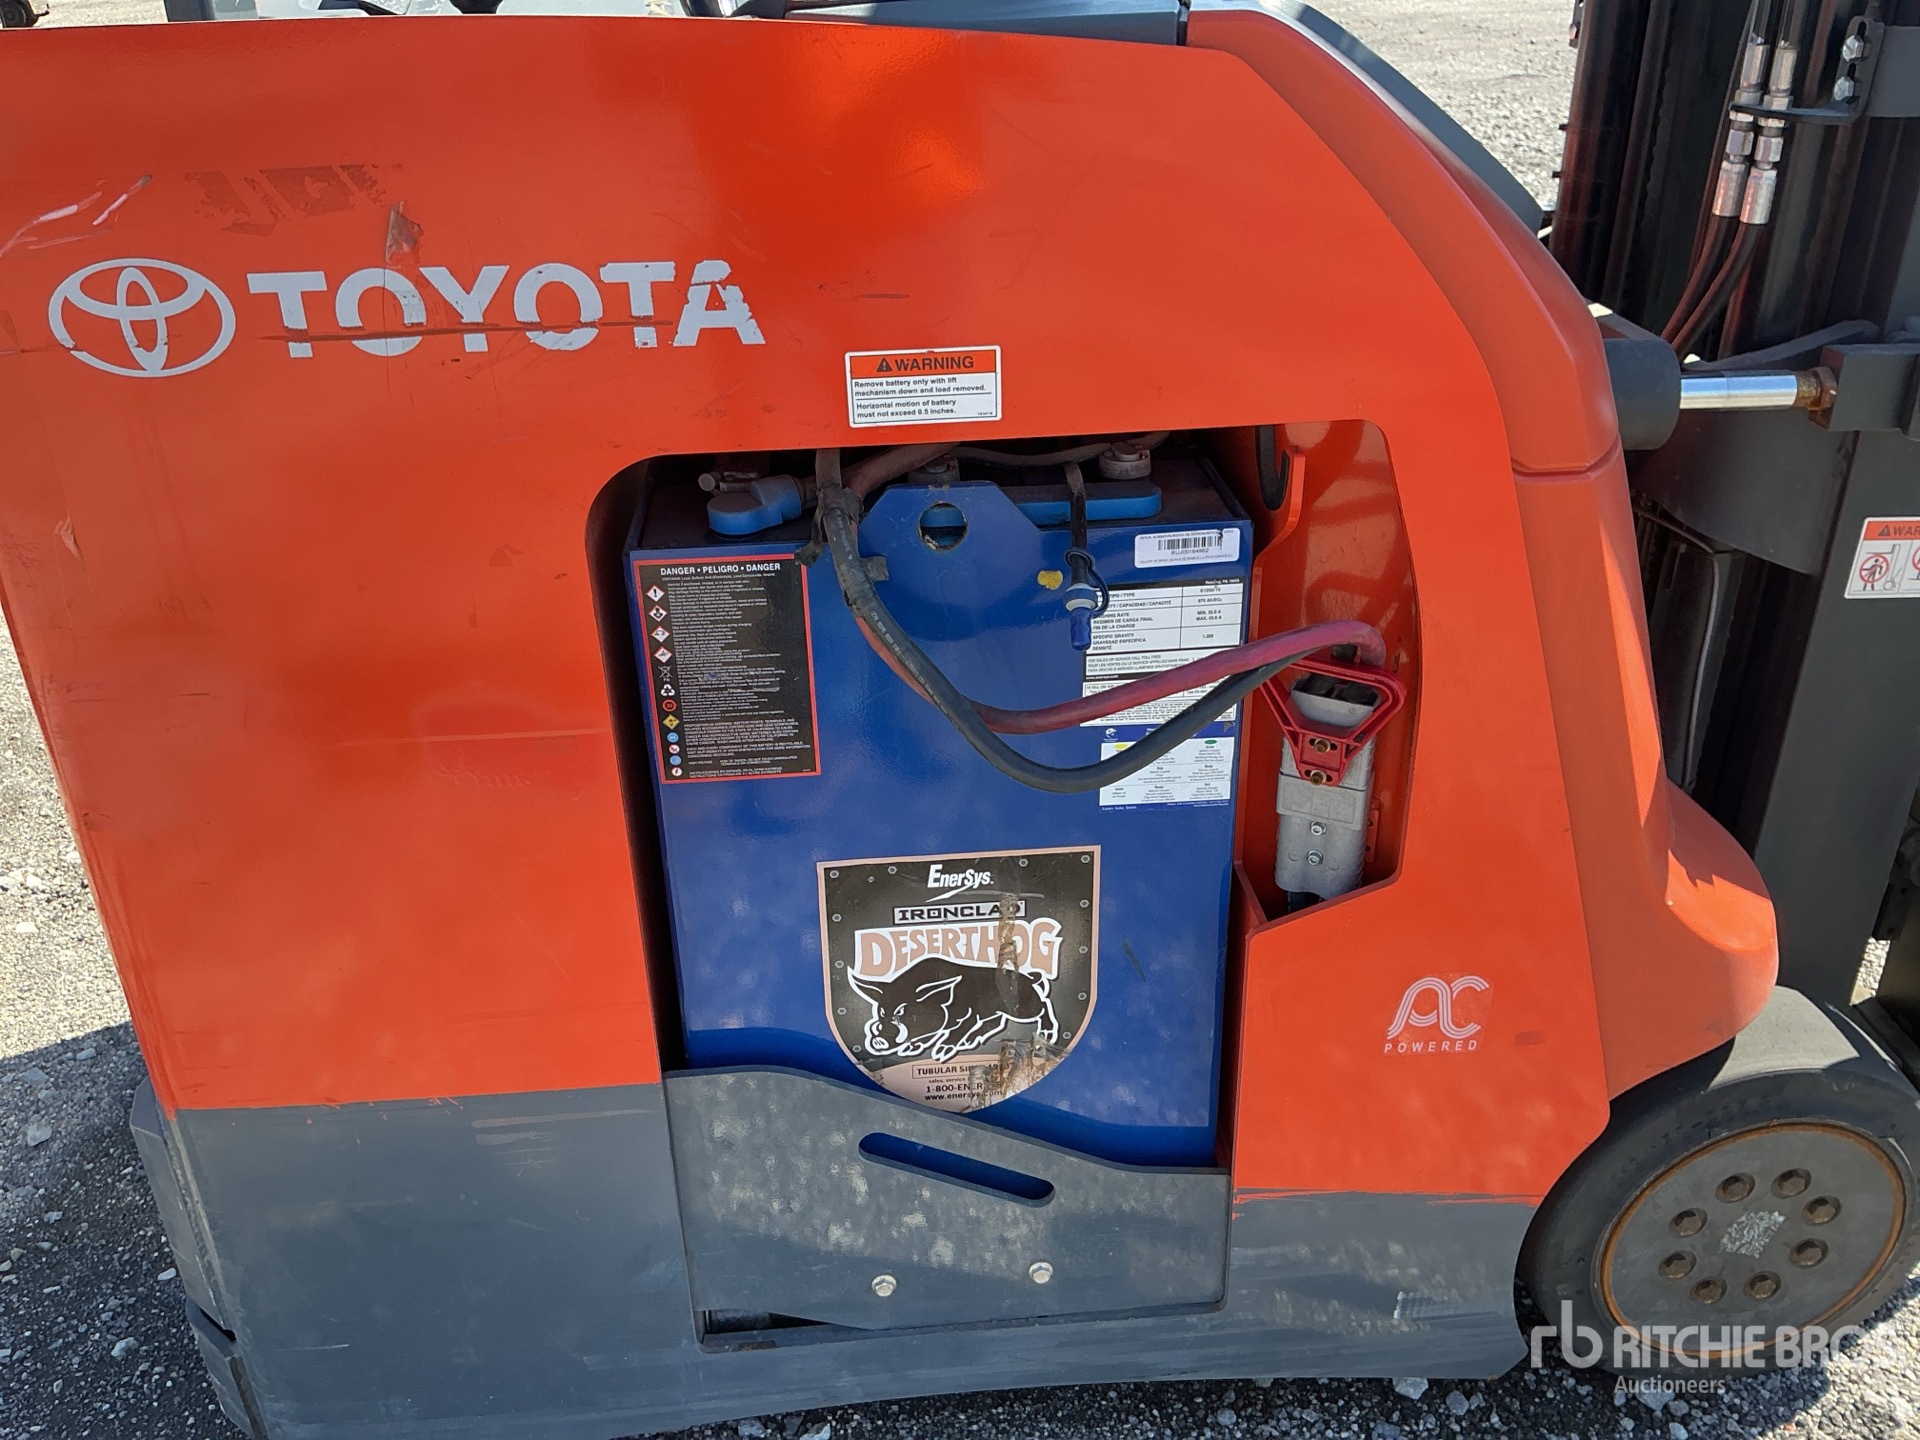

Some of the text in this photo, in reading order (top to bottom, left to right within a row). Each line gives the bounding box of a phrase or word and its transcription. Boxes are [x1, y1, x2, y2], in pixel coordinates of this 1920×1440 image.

[247, 260, 766, 358] TOYOTA
[895, 356, 974, 371] WARNING
[854, 381, 884, 389] Remove
[886, 379, 911, 387] battery
[913, 378, 928, 386] only
[855, 389, 896, 397] mechanism
[856, 401, 893, 410] Horizontal
[895, 400, 921, 408] motion
[931, 399, 957, 407] battery
[930, 407, 957, 415] inches.
[660, 563, 781, 576] DANGER PELIGRO DANGER
[1384, 1040, 1477, 1053] POWERED
[917, 1066, 957, 1075] TUBULAR
